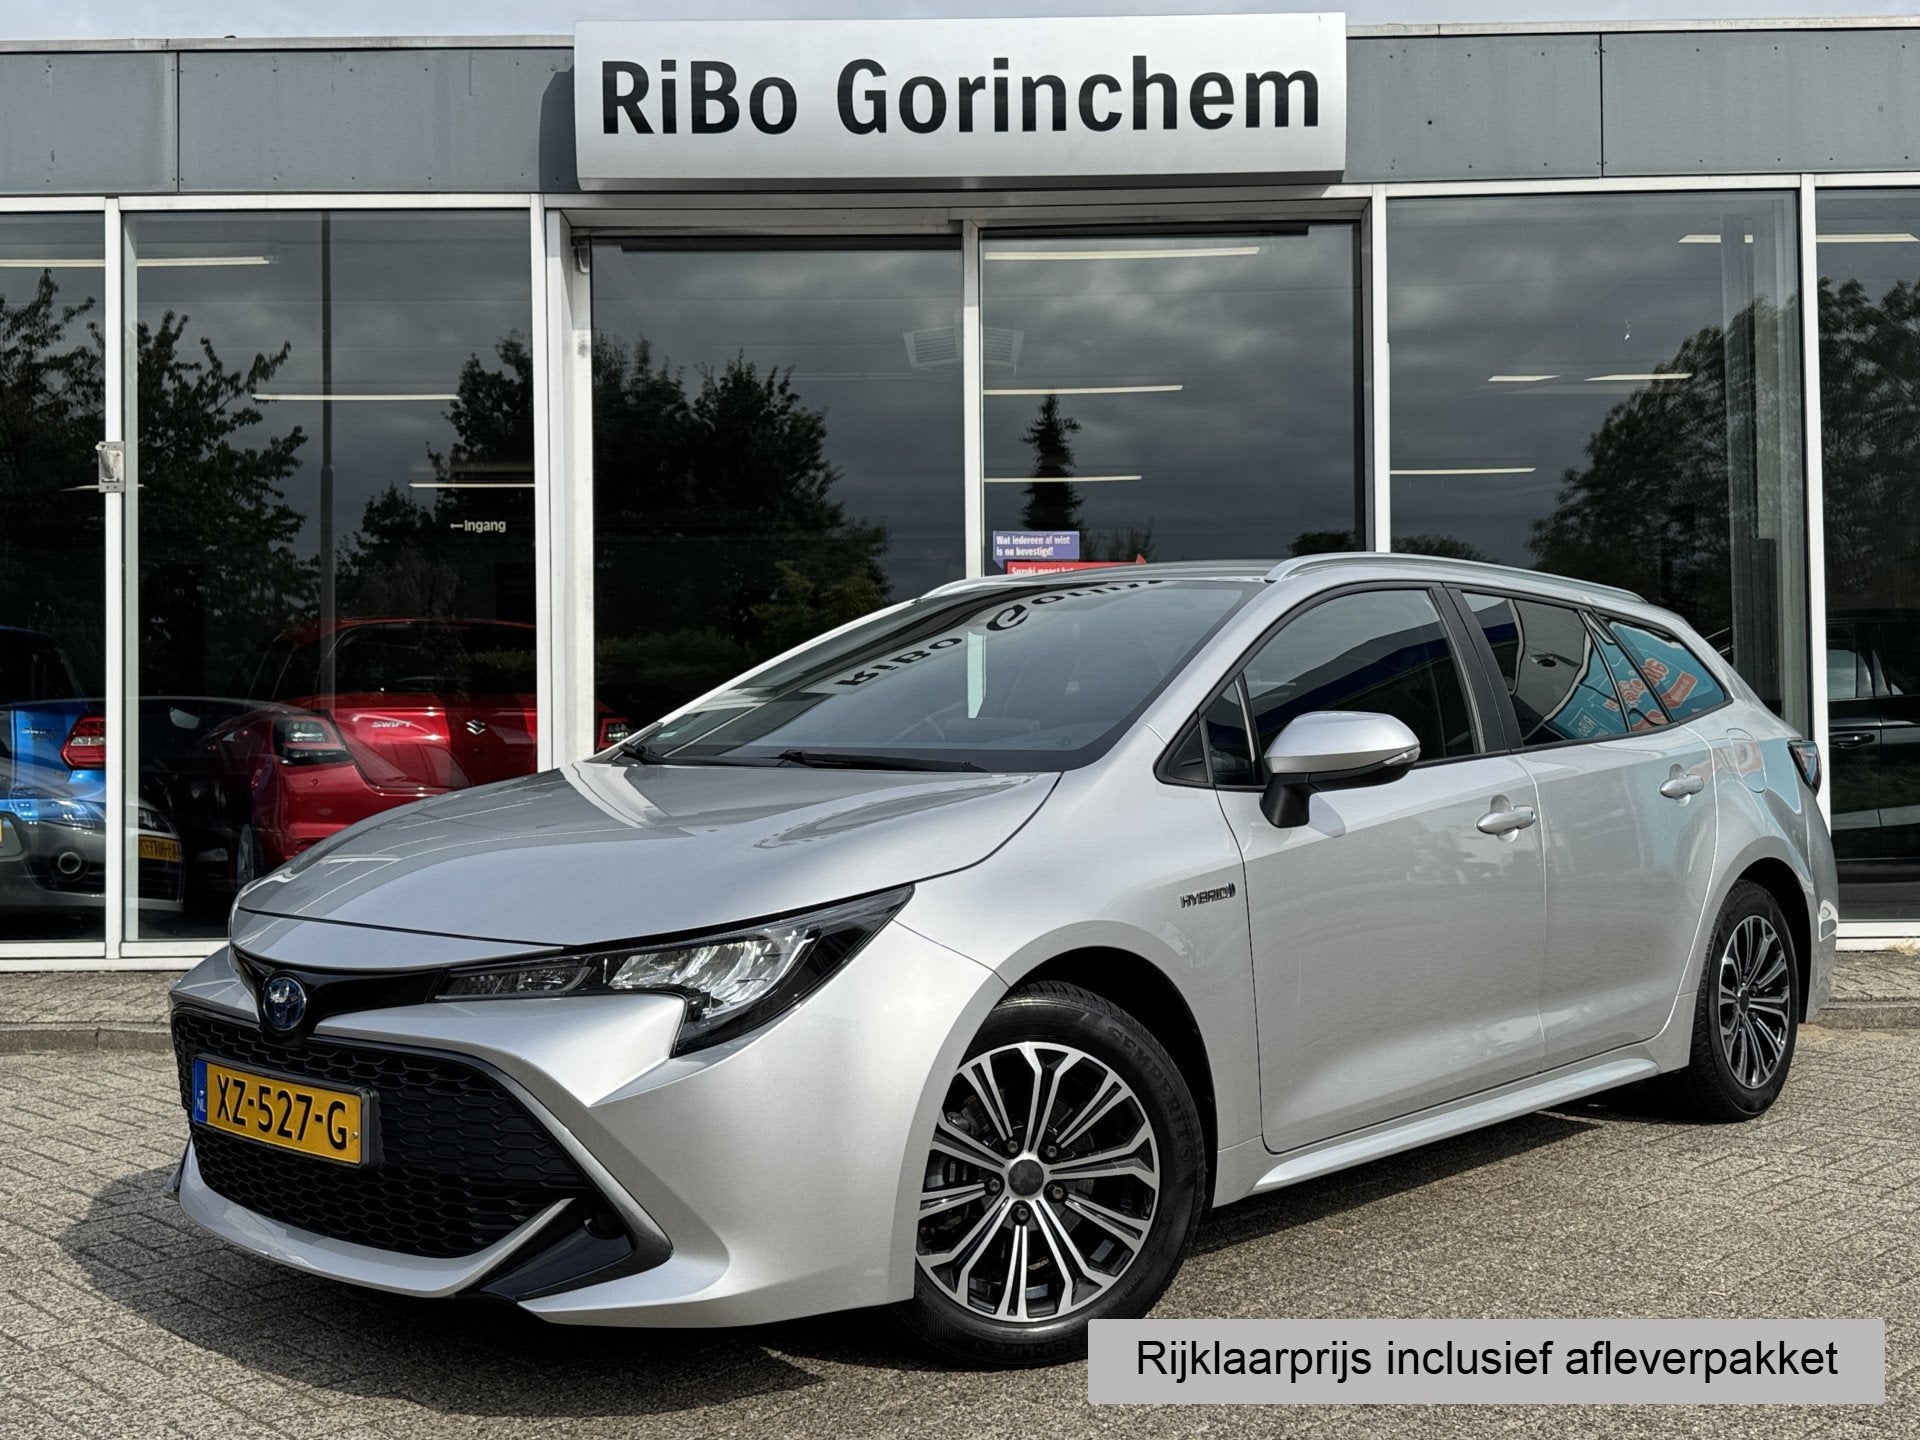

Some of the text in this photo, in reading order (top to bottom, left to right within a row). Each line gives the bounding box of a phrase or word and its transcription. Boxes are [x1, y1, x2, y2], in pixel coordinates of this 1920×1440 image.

[603, 56, 1318, 134] RiBo Gorinchem
[464, 520, 507, 533] Ingang
[996, 535, 1071, 545] Wat iedereen al wist
[996, 547, 1054, 558] is nu bevestigd!
[1011, 566, 1036, 576] Suzuki
[216, 1073, 348, 1151] XZ-527-G
